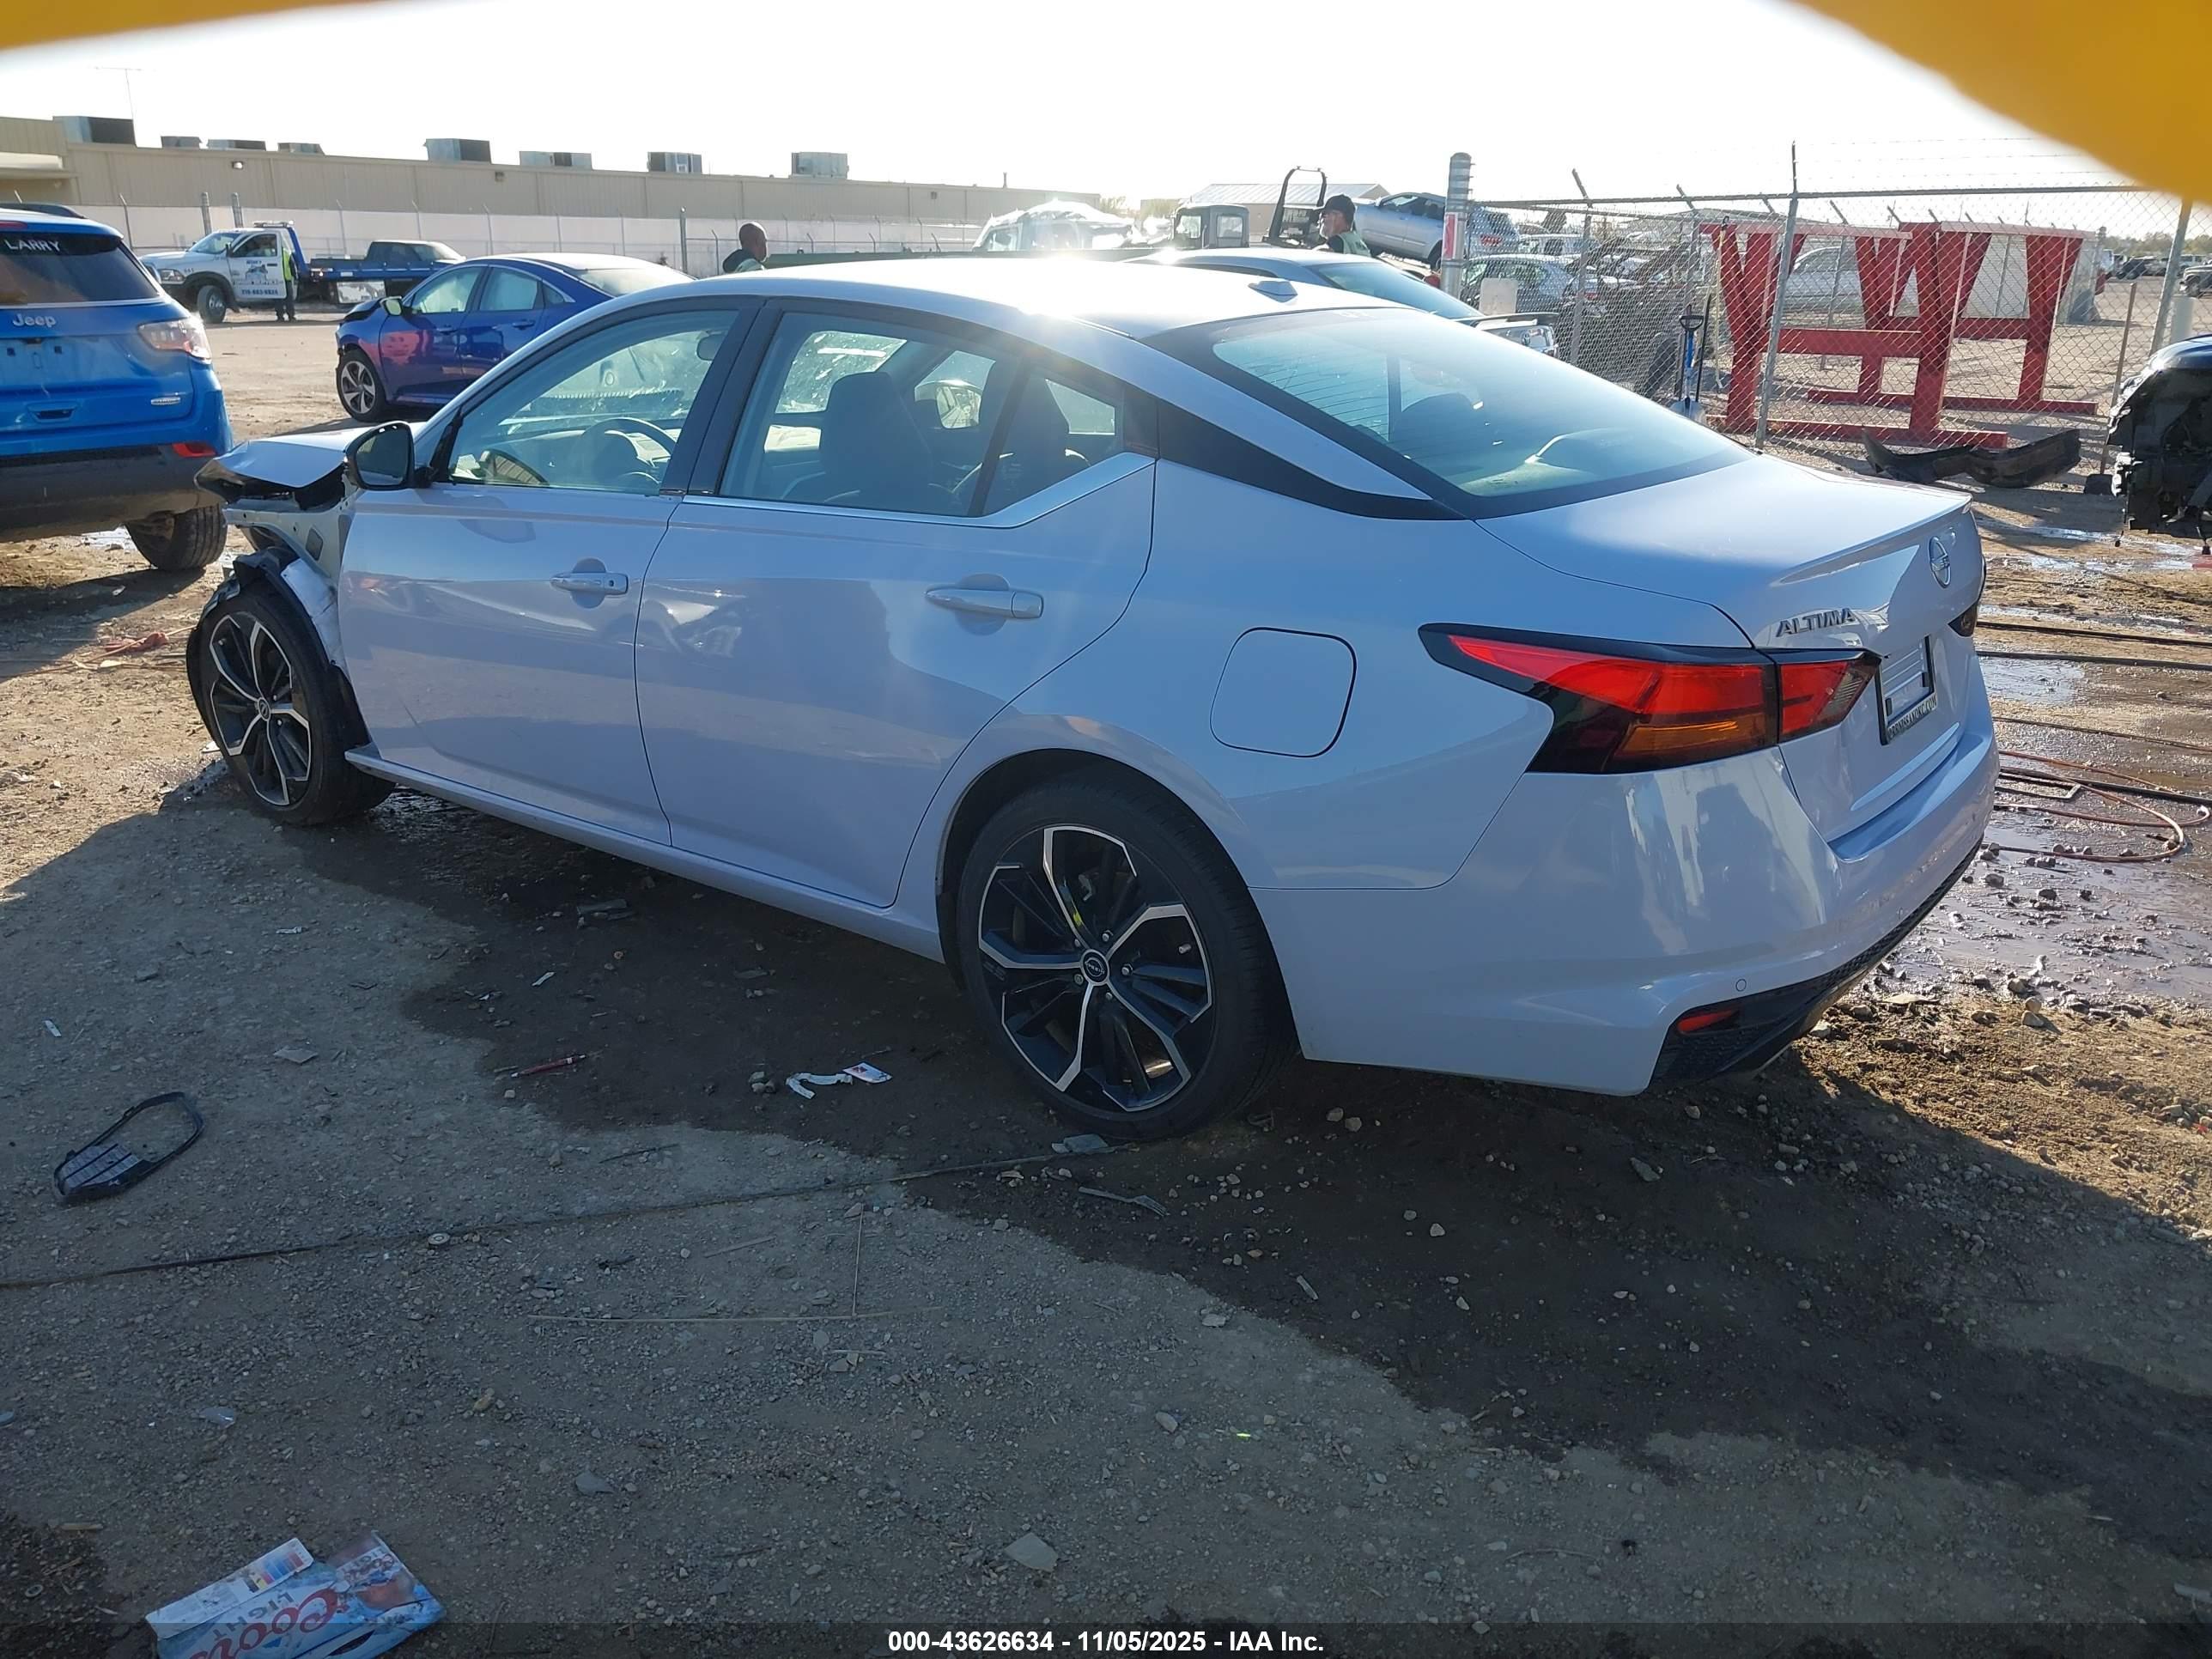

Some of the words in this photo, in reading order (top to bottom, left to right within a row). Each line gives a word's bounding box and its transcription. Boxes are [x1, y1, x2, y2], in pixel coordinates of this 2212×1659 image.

[3, 240, 61, 252] LARRY
[12, 313, 57, 328] Jeep
[1776, 607, 1857, 638] ALTIMA
[211, 1591, 295, 1643] LIGHT
